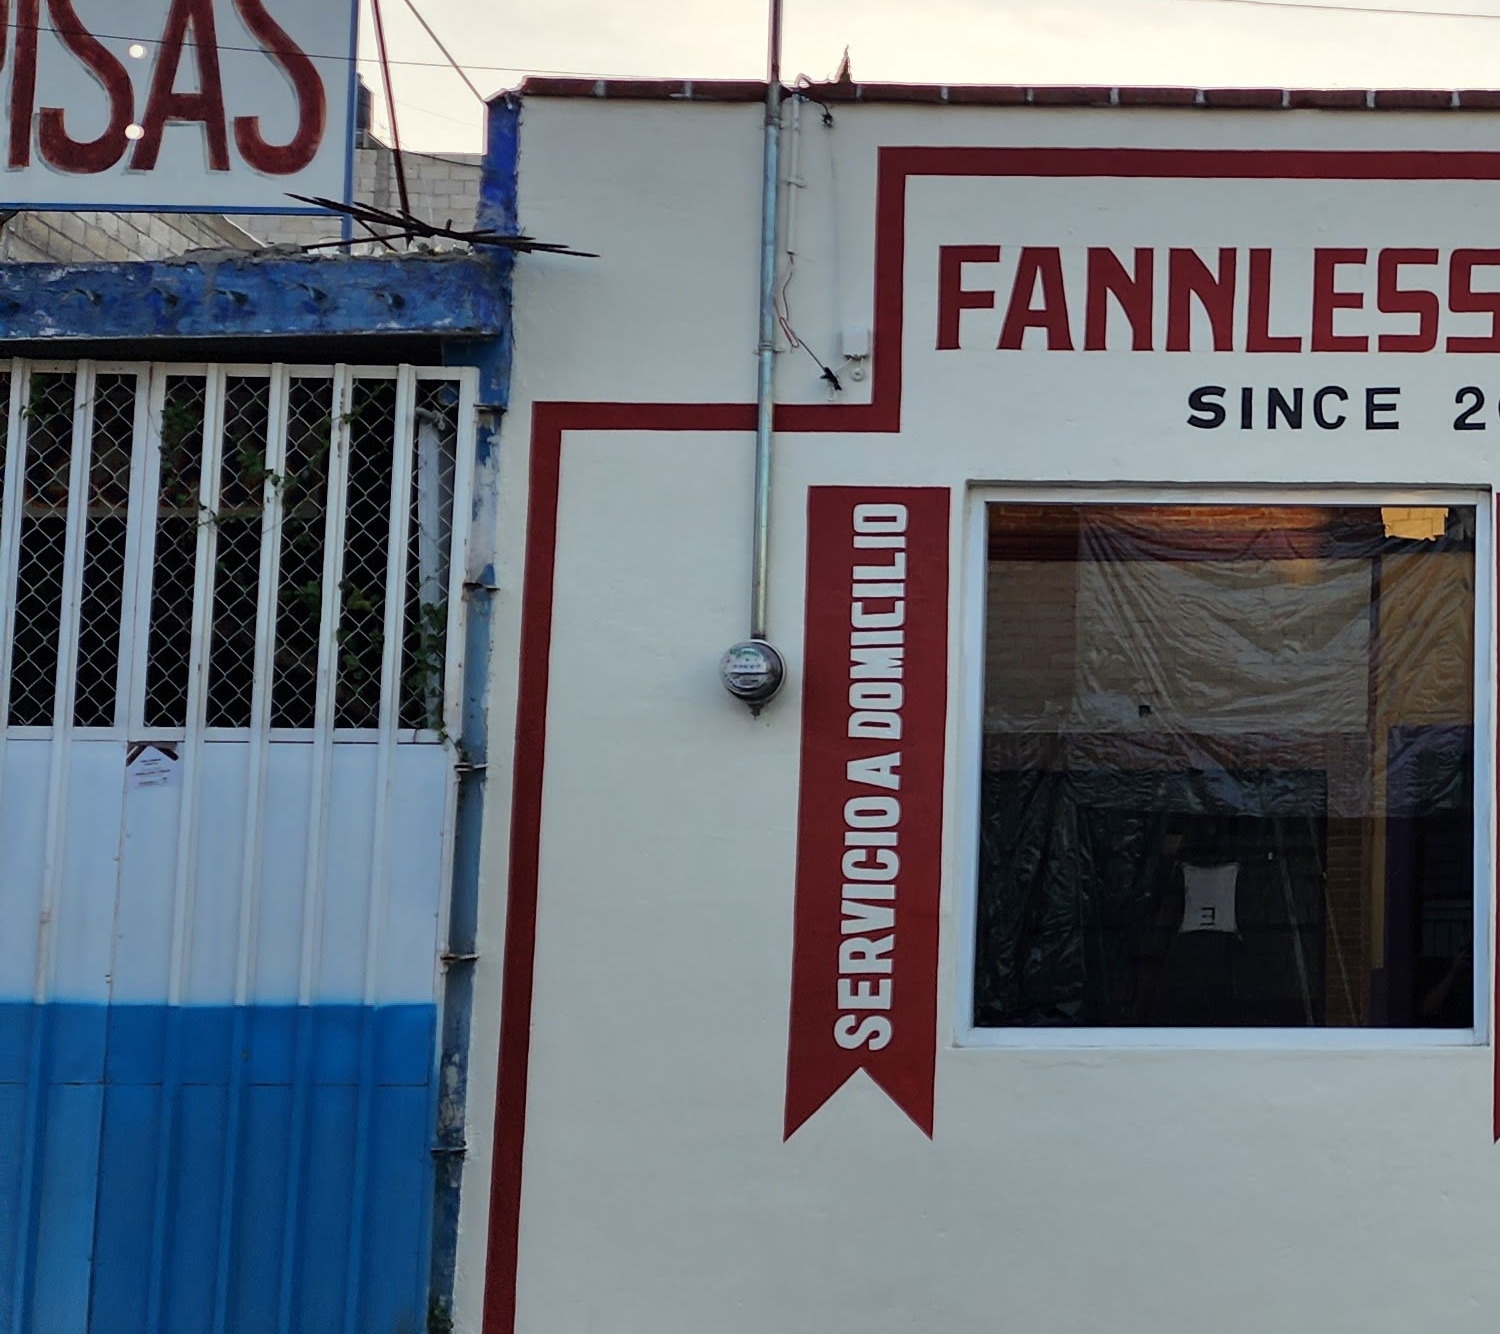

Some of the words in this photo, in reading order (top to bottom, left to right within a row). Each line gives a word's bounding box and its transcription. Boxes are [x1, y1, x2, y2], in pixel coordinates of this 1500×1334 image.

[1186, 384, 1401, 431] SINCE
[847, 502, 908, 741] DOMICILIO
[845, 751, 901, 792] A
[834, 797, 900, 1052] SERVICIO
